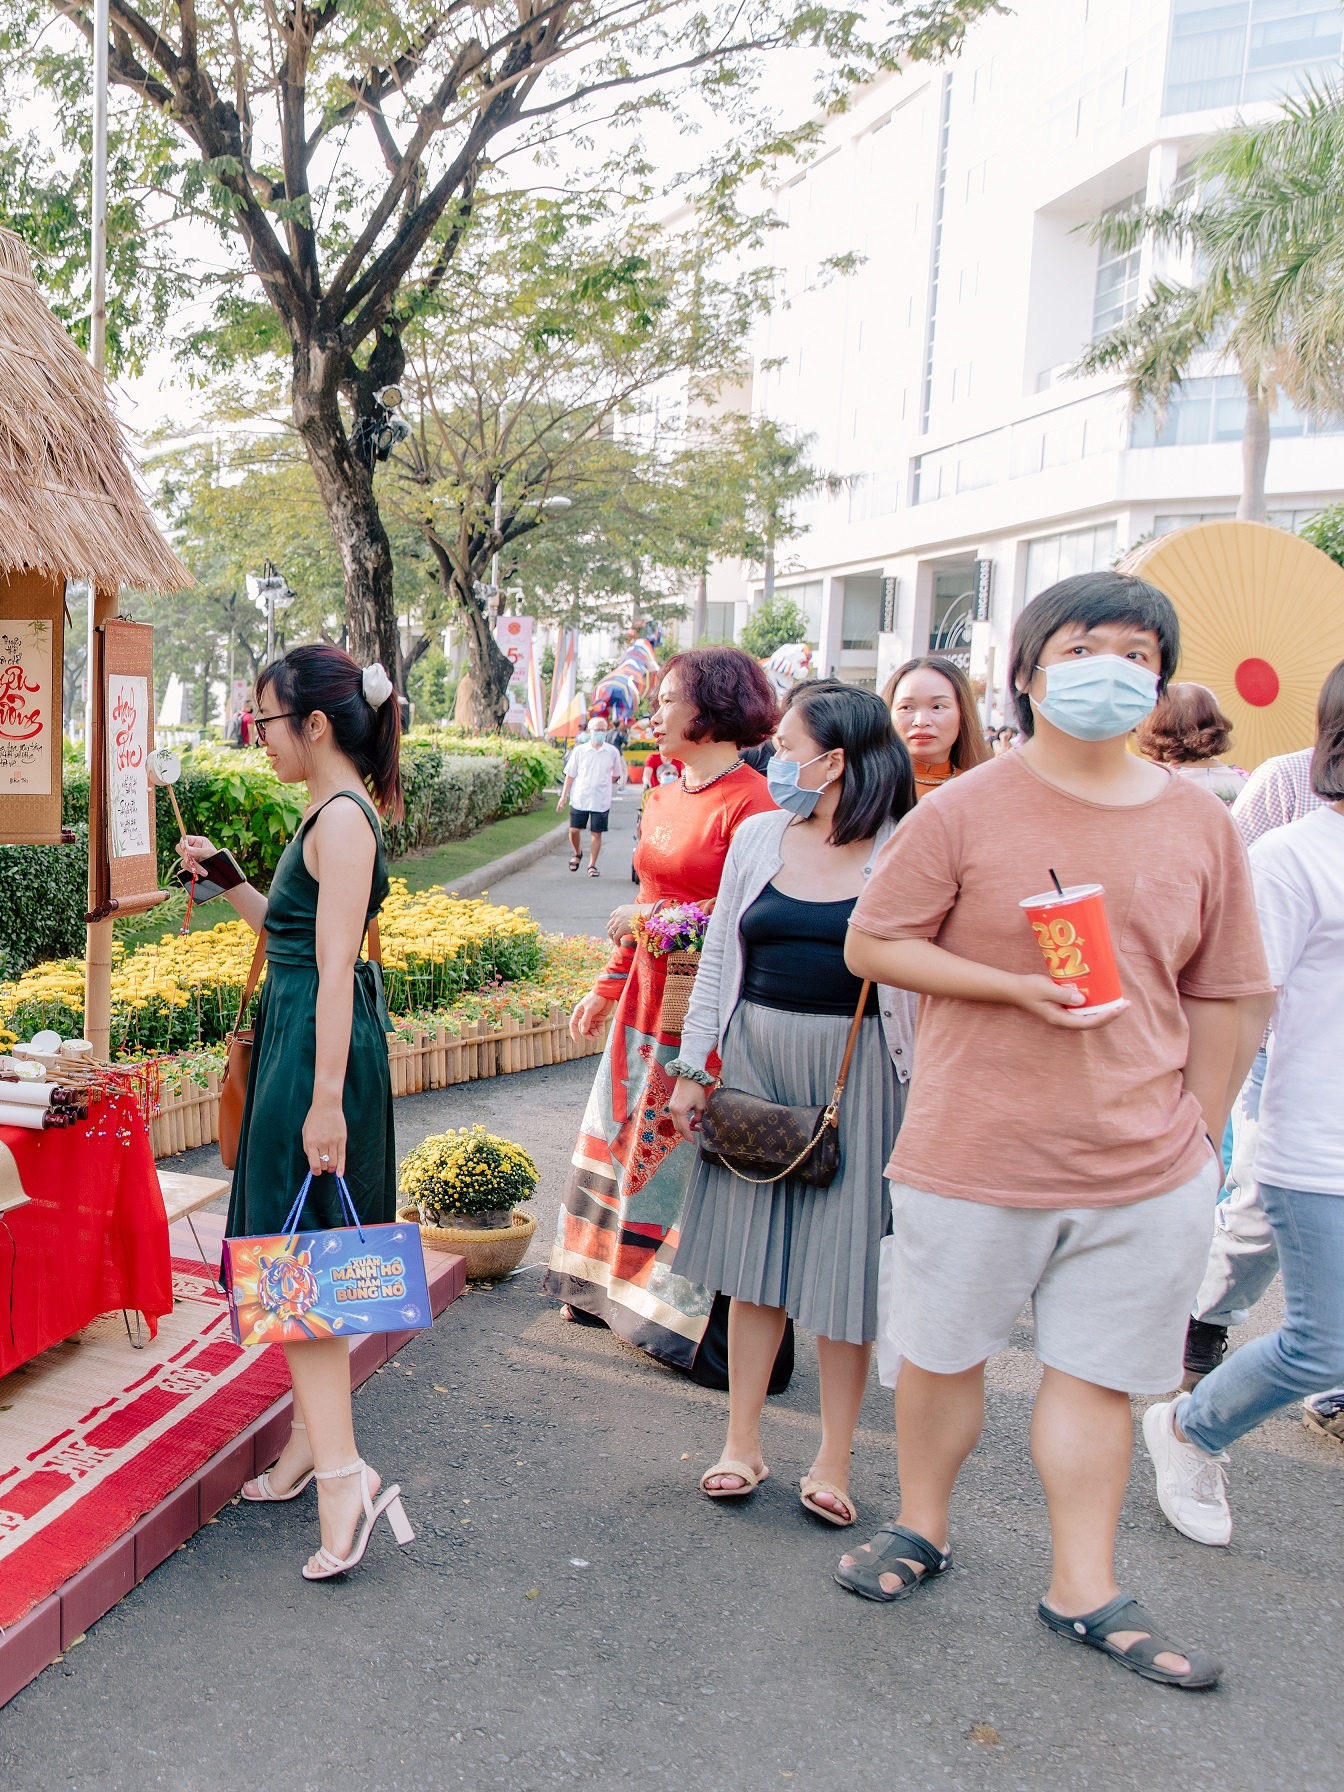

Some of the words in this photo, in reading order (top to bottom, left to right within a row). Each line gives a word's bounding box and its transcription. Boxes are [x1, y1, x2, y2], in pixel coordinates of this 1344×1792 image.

[1032, 919, 1077, 949] 20
[1042, 946, 1090, 978] 22
[351, 1257, 381, 1269] XUÂN
[332, 1265, 377, 1281] MÃNH
[357, 1277, 381, 1288] NĂM
[336, 1286, 379, 1302] BÙNG
